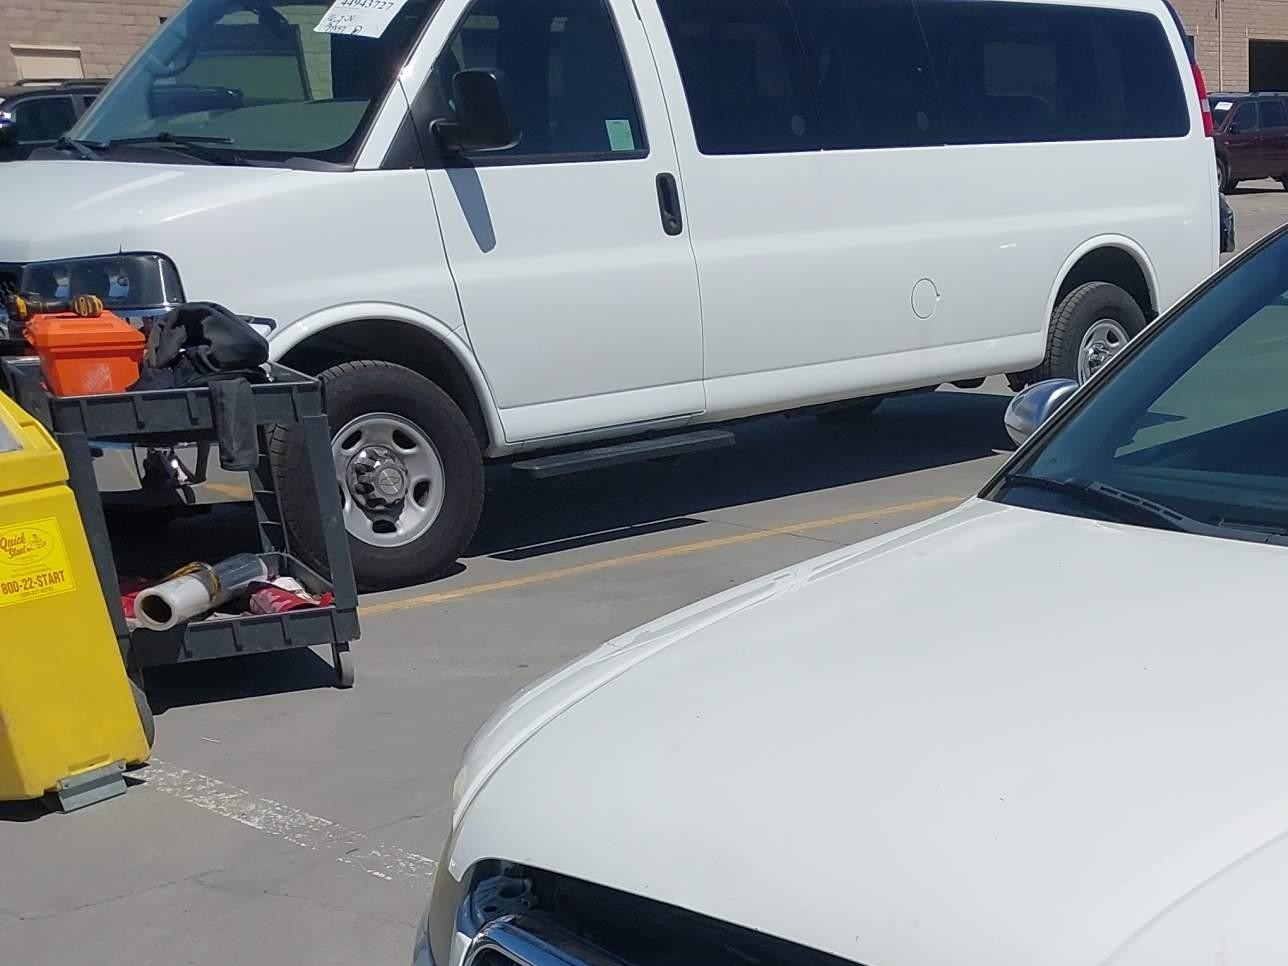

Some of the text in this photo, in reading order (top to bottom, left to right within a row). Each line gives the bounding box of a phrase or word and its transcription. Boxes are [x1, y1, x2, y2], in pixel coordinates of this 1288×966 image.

[0, 532, 26, 552] Quick
[8, 545, 27, 560] Start
[1, 569, 66, 595] 800-22-START
